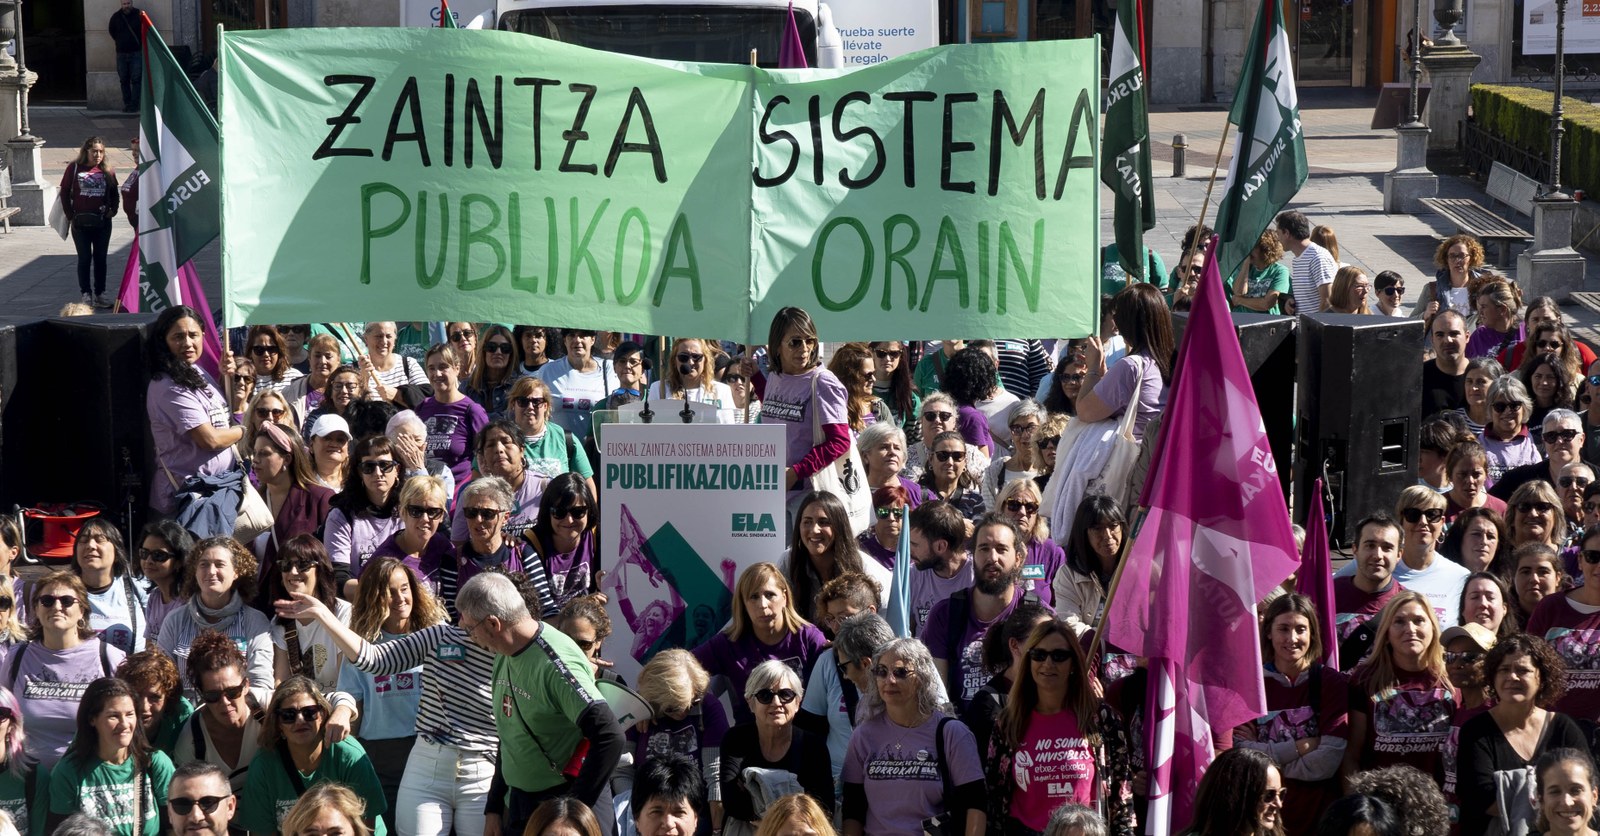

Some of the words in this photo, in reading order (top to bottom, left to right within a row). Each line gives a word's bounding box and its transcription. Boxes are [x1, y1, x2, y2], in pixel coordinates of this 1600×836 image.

[877, 27, 915, 37] suerte
[311, 73, 669, 184] ZAINTZA
[752, 87, 1094, 201] SISTEMA
[360, 181, 704, 311] PUBLIKOA
[811, 213, 1045, 315] ORAIN
[607, 443, 640, 457] EUSKAL
[640, 443, 676, 457] ZAINTZA
[678, 443, 715, 457] SISTEMA
[717, 444, 743, 457] BATEN
[745, 444, 776, 457] BIDEAN
[606, 463, 778, 490] PUBLIFIKAZIOA!!!
[731, 513, 776, 532] ELA
[440, 647, 462, 657] ELA
[1035, 739, 1052, 751] NO
[1035, 749, 1091, 763] INVISIBLES
[868, 766, 920, 776] BORROKAN
[1035, 762, 1086, 773] etxez-etxeko
[1047, 782, 1074, 795] ELA
